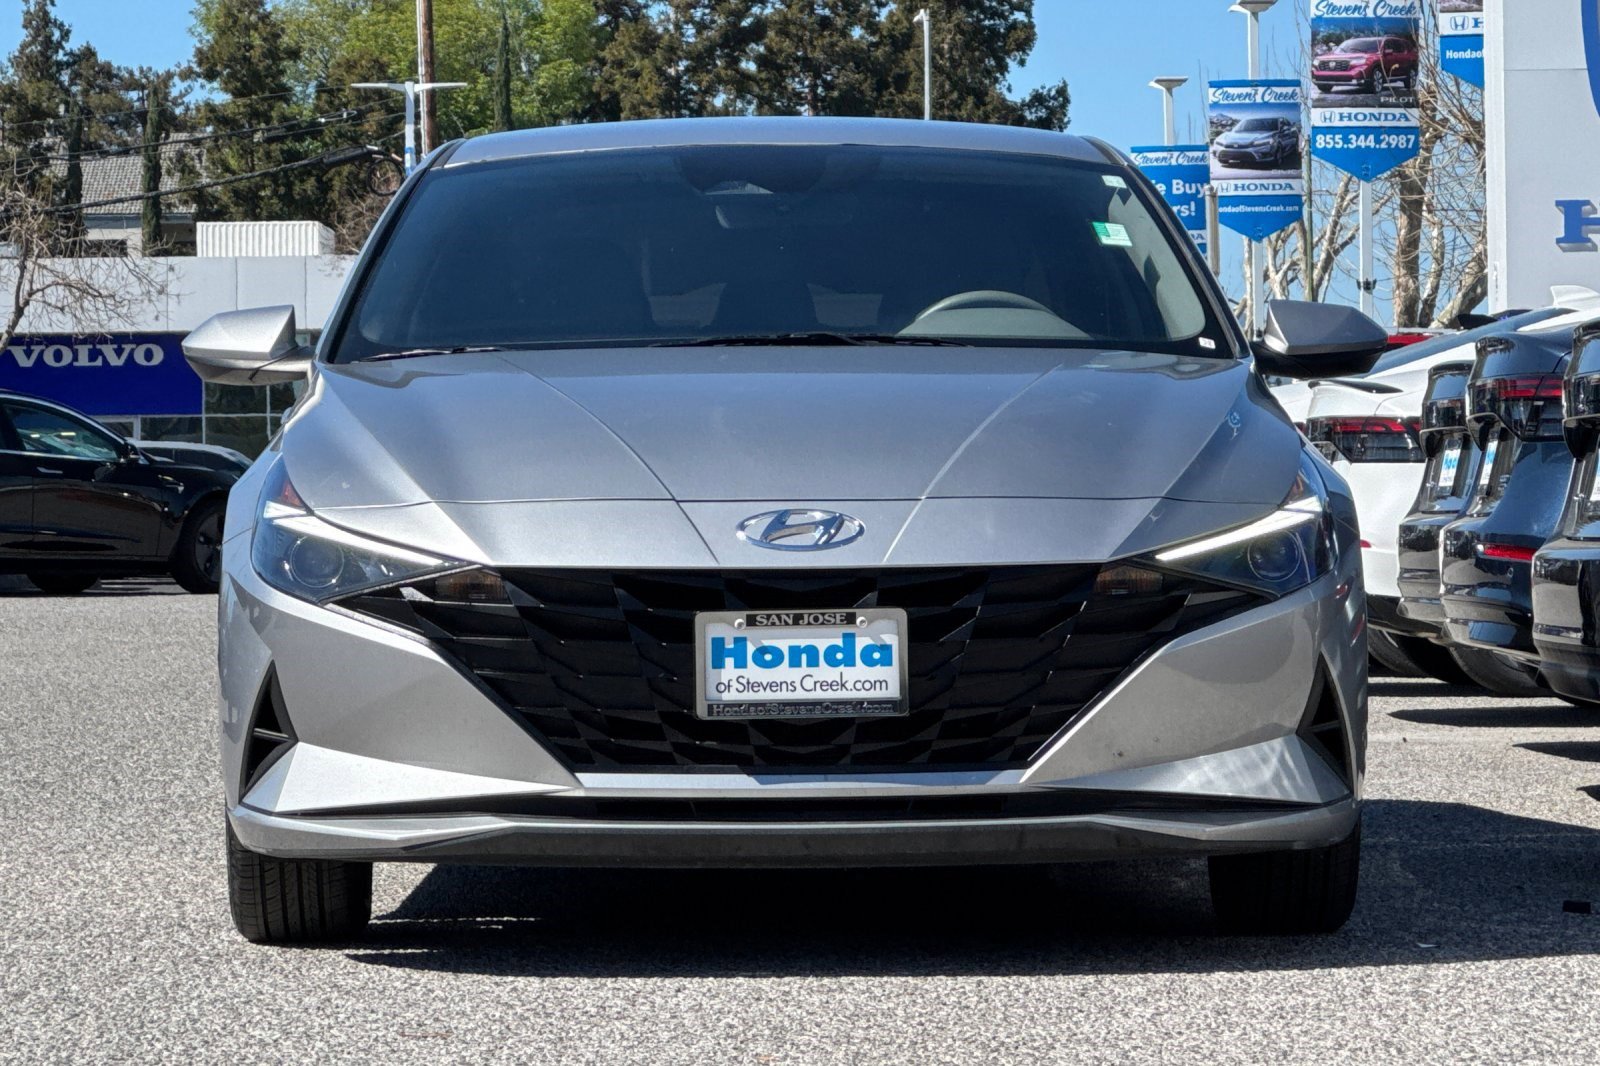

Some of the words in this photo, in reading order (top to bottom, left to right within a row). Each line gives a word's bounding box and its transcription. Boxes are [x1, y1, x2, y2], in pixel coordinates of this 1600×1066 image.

[1314, 0, 1370, 18] Stevens
[1372, 0, 1417, 17] Creek
[1212, 87, 1258, 104] Stevens
[1260, 86, 1299, 103] Creek
[1337, 112, 1411, 122] HONDA
[1315, 133, 1415, 149] 855.344.2987
[1171, 179, 1206, 198] Buy
[1233, 182, 1295, 192] HONDA
[1217, 204, 1299, 214] ondaofStevensCreek.com
[8, 343, 165, 368] VOLVO
[755, 613, 794, 626] SAN
[798, 612, 848, 625] JOSE
[711, 632, 893, 670] Honda
